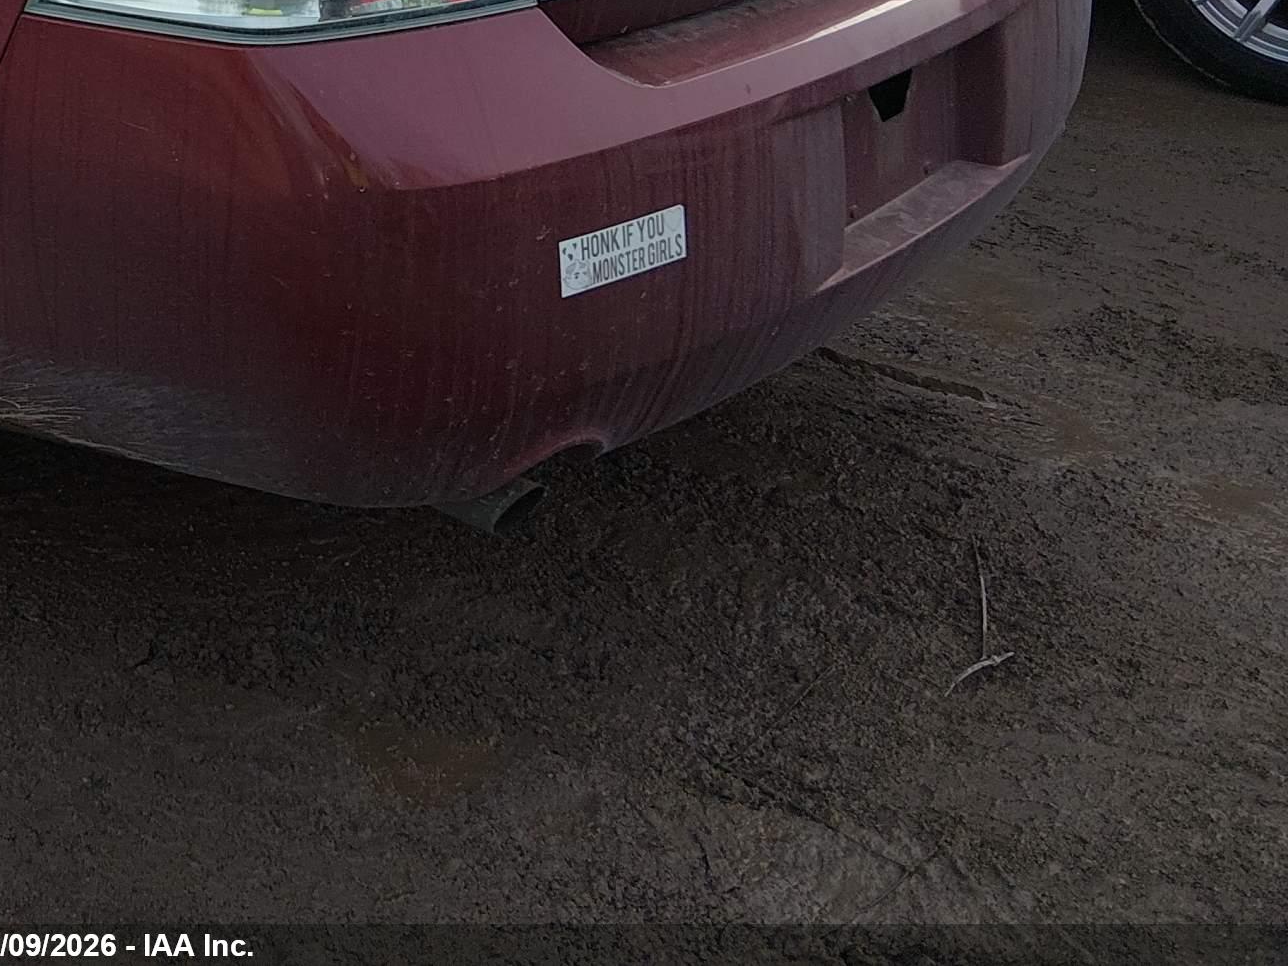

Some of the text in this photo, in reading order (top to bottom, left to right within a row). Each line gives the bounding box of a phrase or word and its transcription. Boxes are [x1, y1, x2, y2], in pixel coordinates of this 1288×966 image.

[580, 213, 665, 261] HONK IF YOU
[592, 233, 683, 284] MONSTER GIRLS
